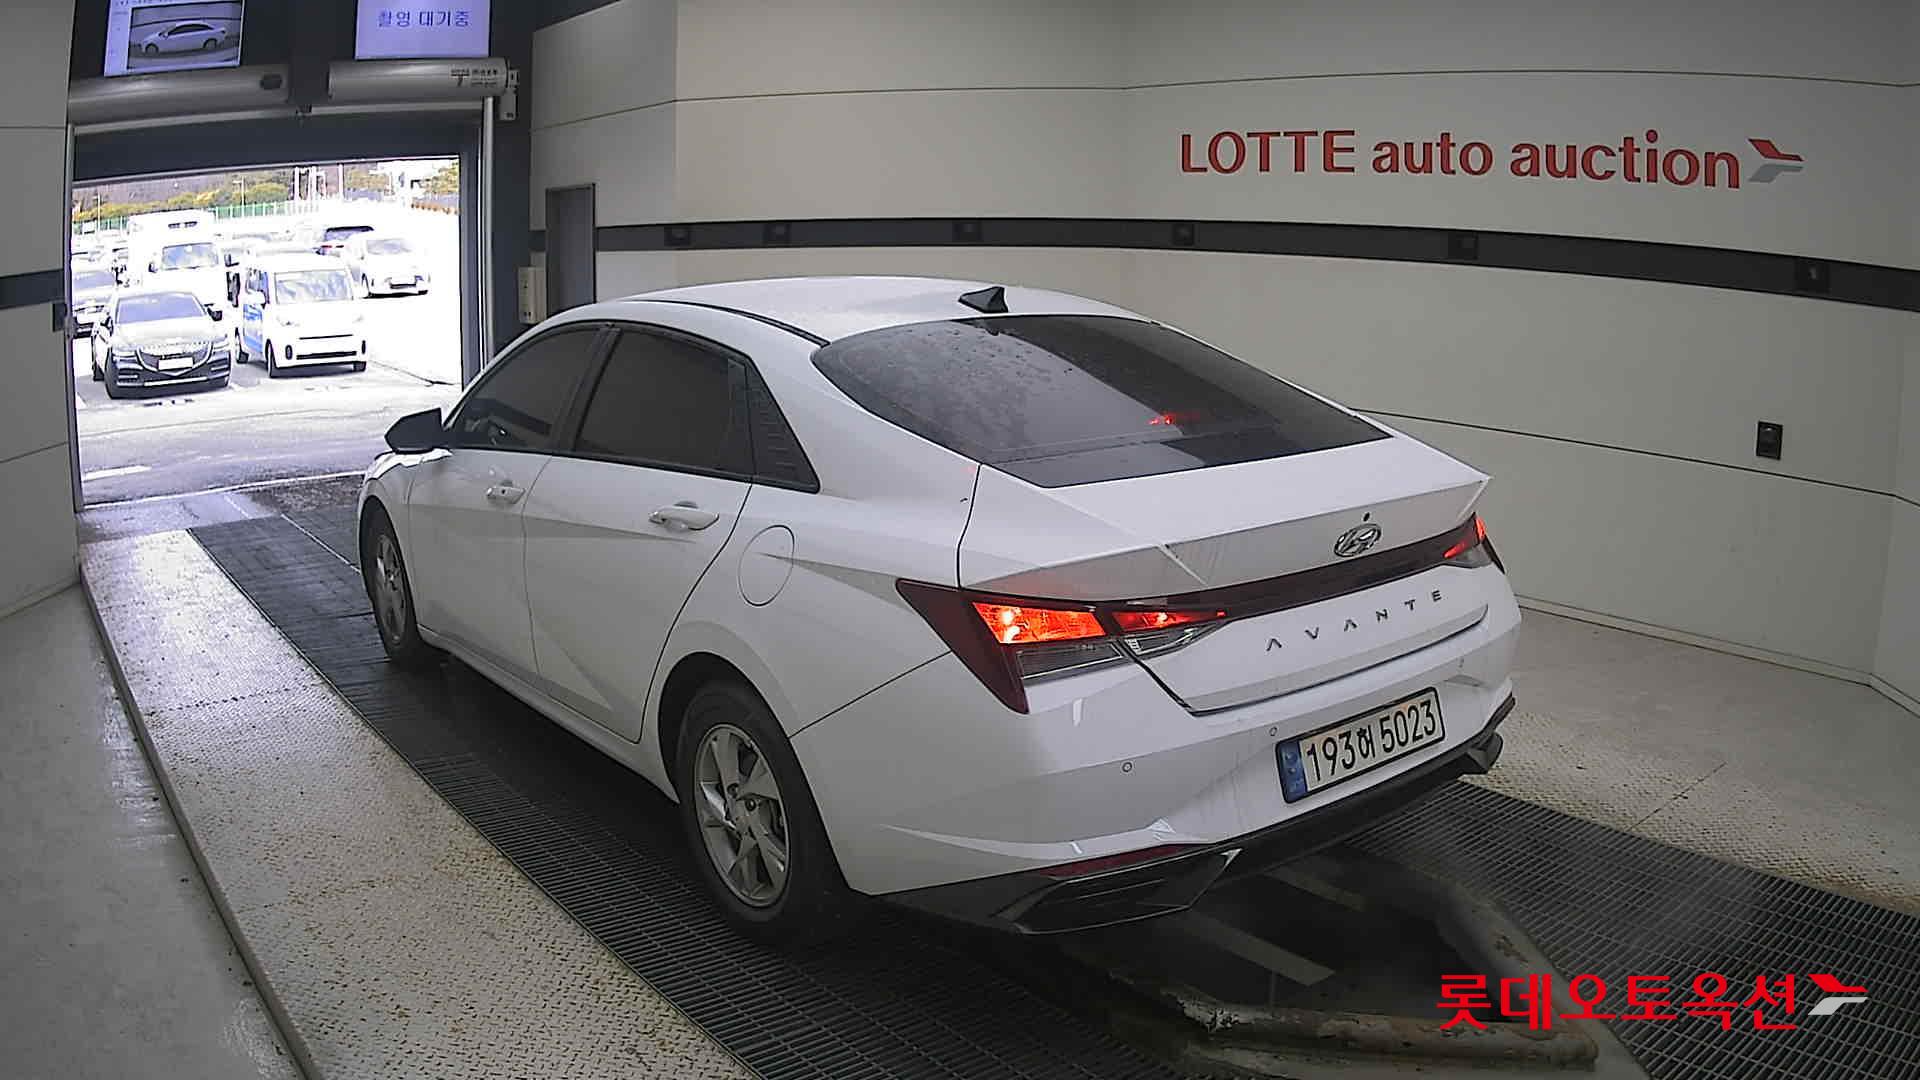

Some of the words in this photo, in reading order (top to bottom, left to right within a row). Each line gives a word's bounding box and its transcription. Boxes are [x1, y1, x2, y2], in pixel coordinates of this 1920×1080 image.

[418, 10, 471, 28] 대기중
[1182, 130, 1354, 174] LOTTE
[1372, 133, 1495, 177] auto
[1510, 129, 1742, 190] auction
[1266, 589, 1443, 651] AVANTE
[1306, 724, 1377, 782] 193허
[1379, 700, 1437, 754] 5023
